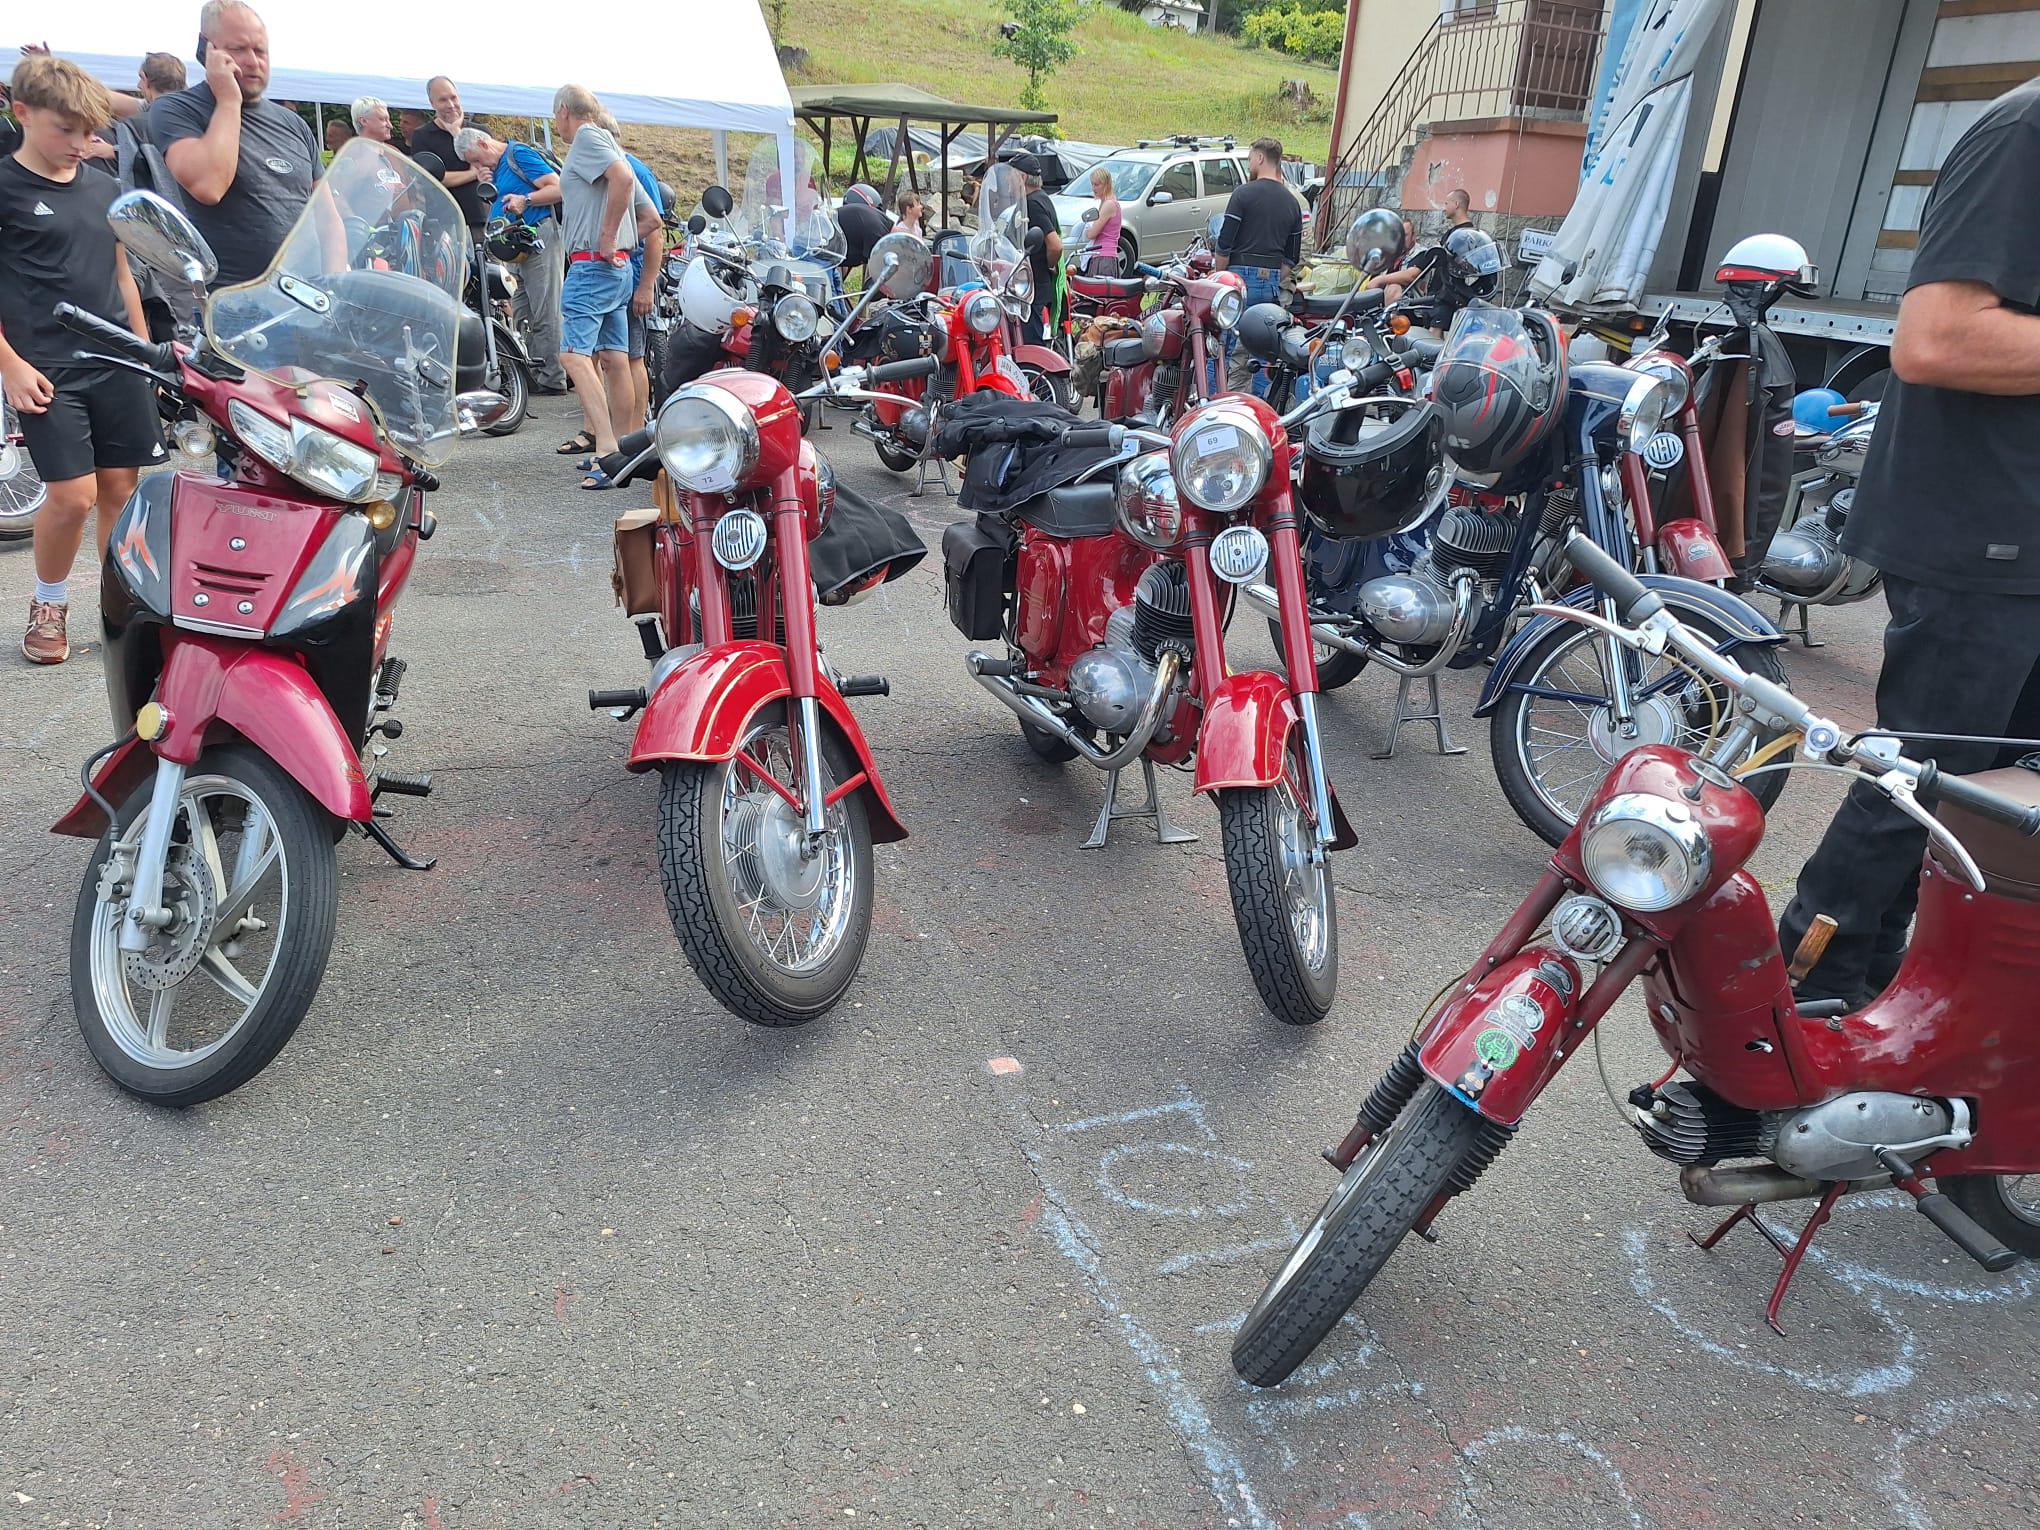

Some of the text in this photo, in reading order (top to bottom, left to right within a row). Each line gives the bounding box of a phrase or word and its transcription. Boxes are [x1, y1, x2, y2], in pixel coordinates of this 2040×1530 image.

[1207, 436, 1218, 446] 69
[702, 476, 713, 484] 72
[216, 503, 274, 521] YUKI
